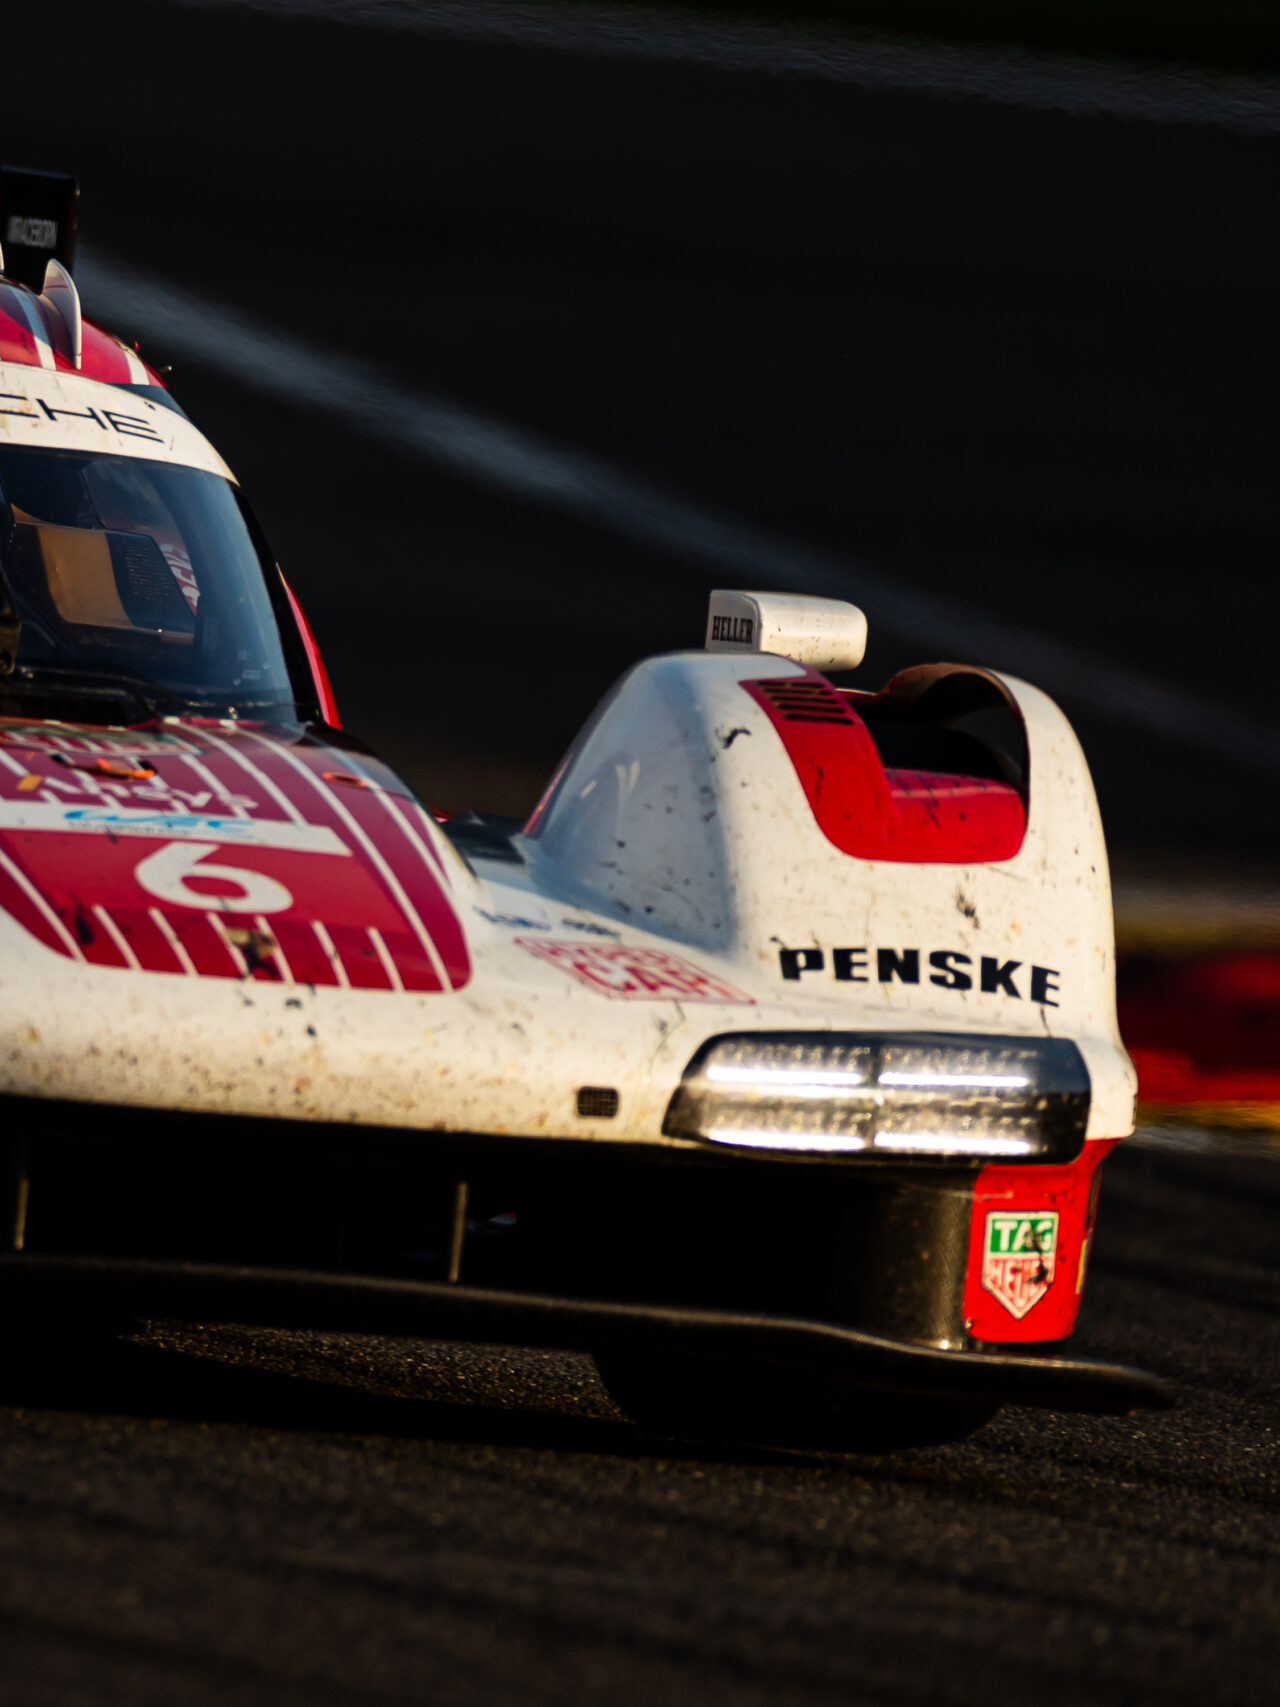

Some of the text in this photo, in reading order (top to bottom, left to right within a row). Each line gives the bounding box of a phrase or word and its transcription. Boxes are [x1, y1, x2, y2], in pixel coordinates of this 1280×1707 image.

[713, 616, 754, 645] HELLER
[133, 842, 294, 914] 6
[779, 948, 1061, 1008] PENSKE
[993, 1220, 1053, 1253] TAG
